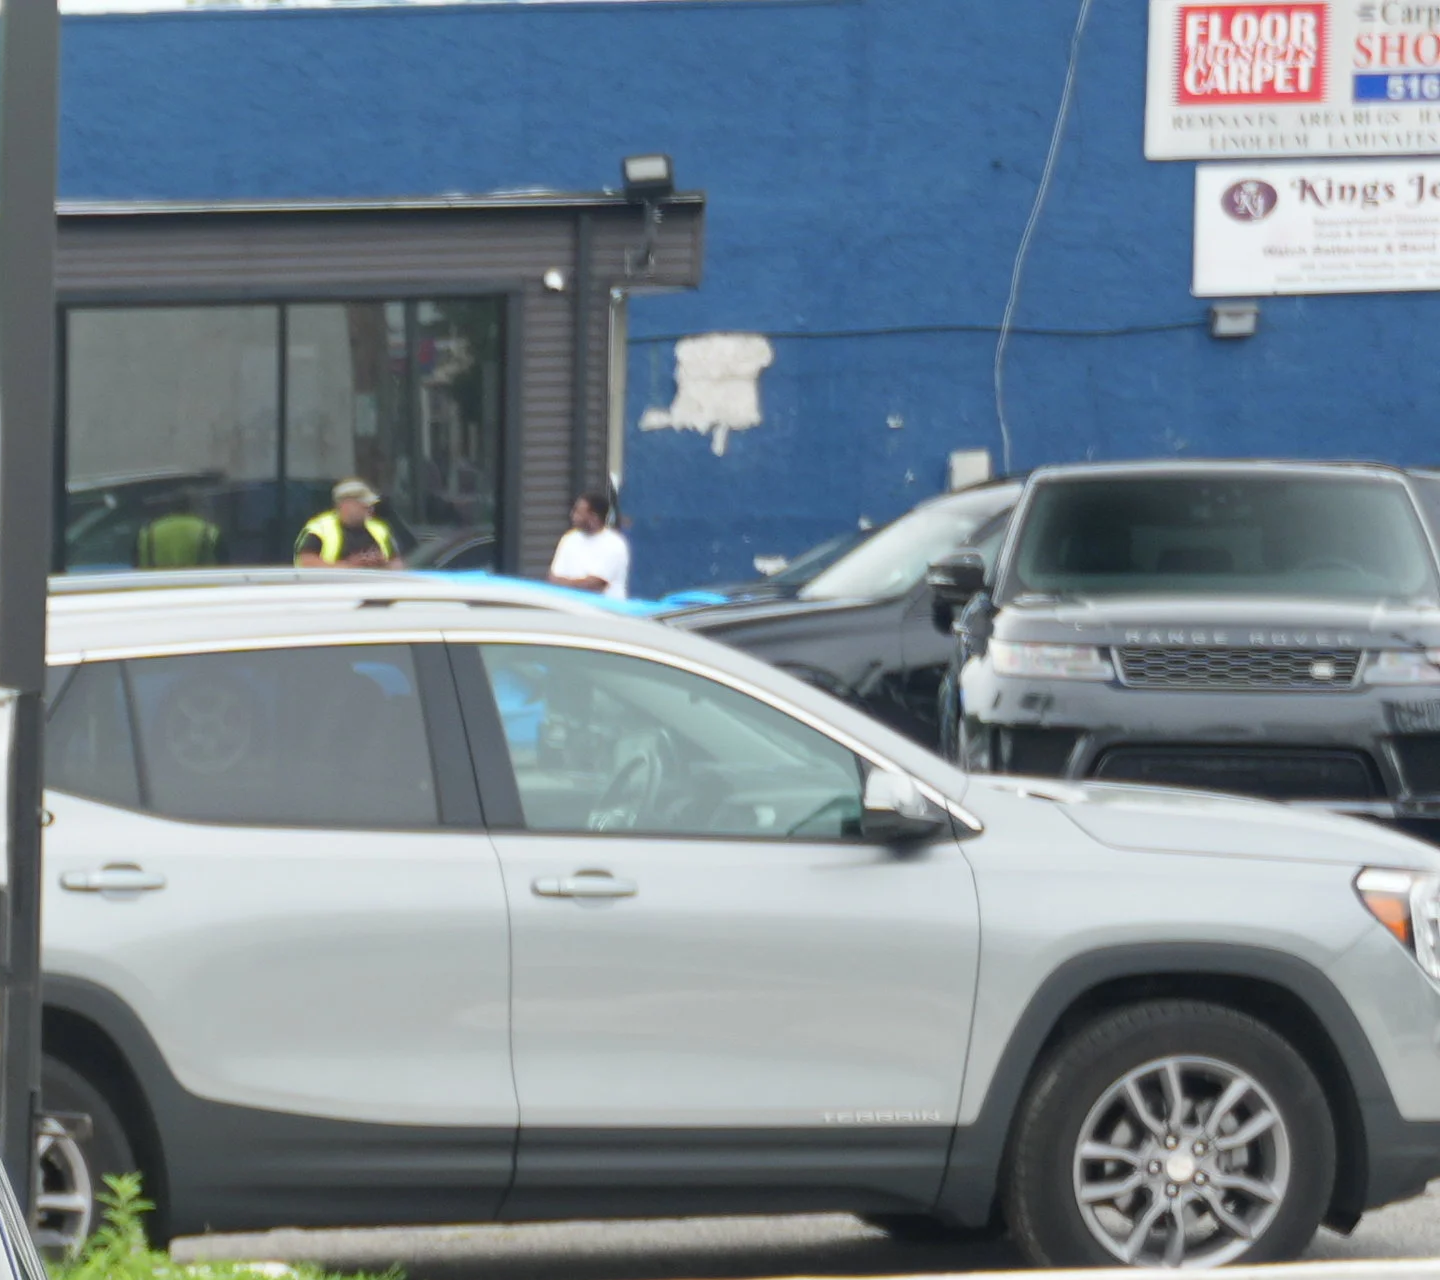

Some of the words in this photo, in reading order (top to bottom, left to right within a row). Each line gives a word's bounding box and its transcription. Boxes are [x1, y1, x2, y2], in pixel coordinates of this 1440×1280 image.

[1185, 12, 1317, 50] FLOOR
[1183, 57, 1315, 95] CARPET
[1291, 176, 1398, 208] Kings
[1125, 631, 1228, 645] RANGE
[1249, 630, 1354, 645] ROVER
